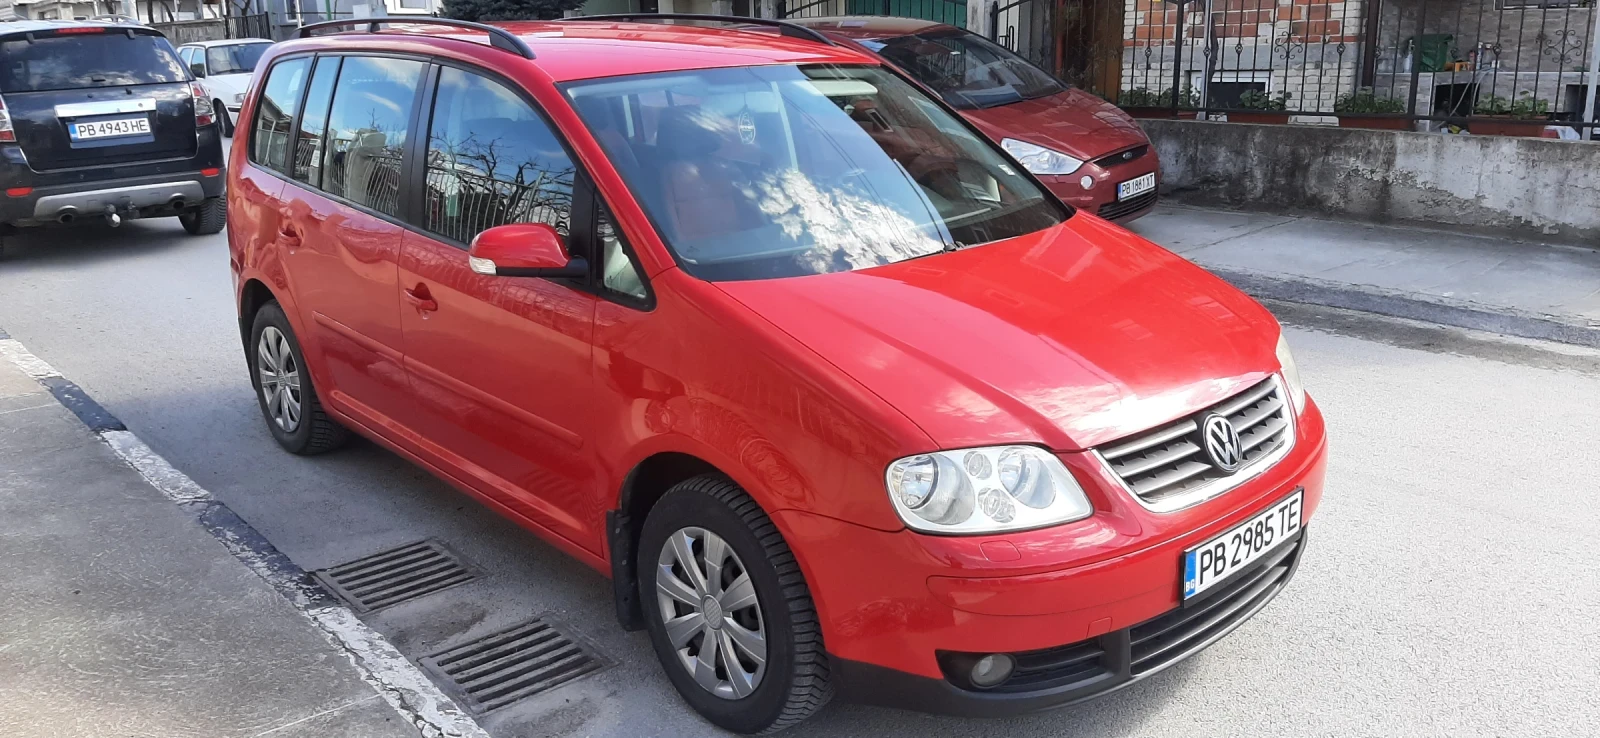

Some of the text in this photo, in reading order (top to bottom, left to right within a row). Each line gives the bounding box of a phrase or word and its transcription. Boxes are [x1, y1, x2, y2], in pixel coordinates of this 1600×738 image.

[78, 119, 148, 137] PB 4943 HE
[1199, 497, 1299, 585] PB 2985 TE
